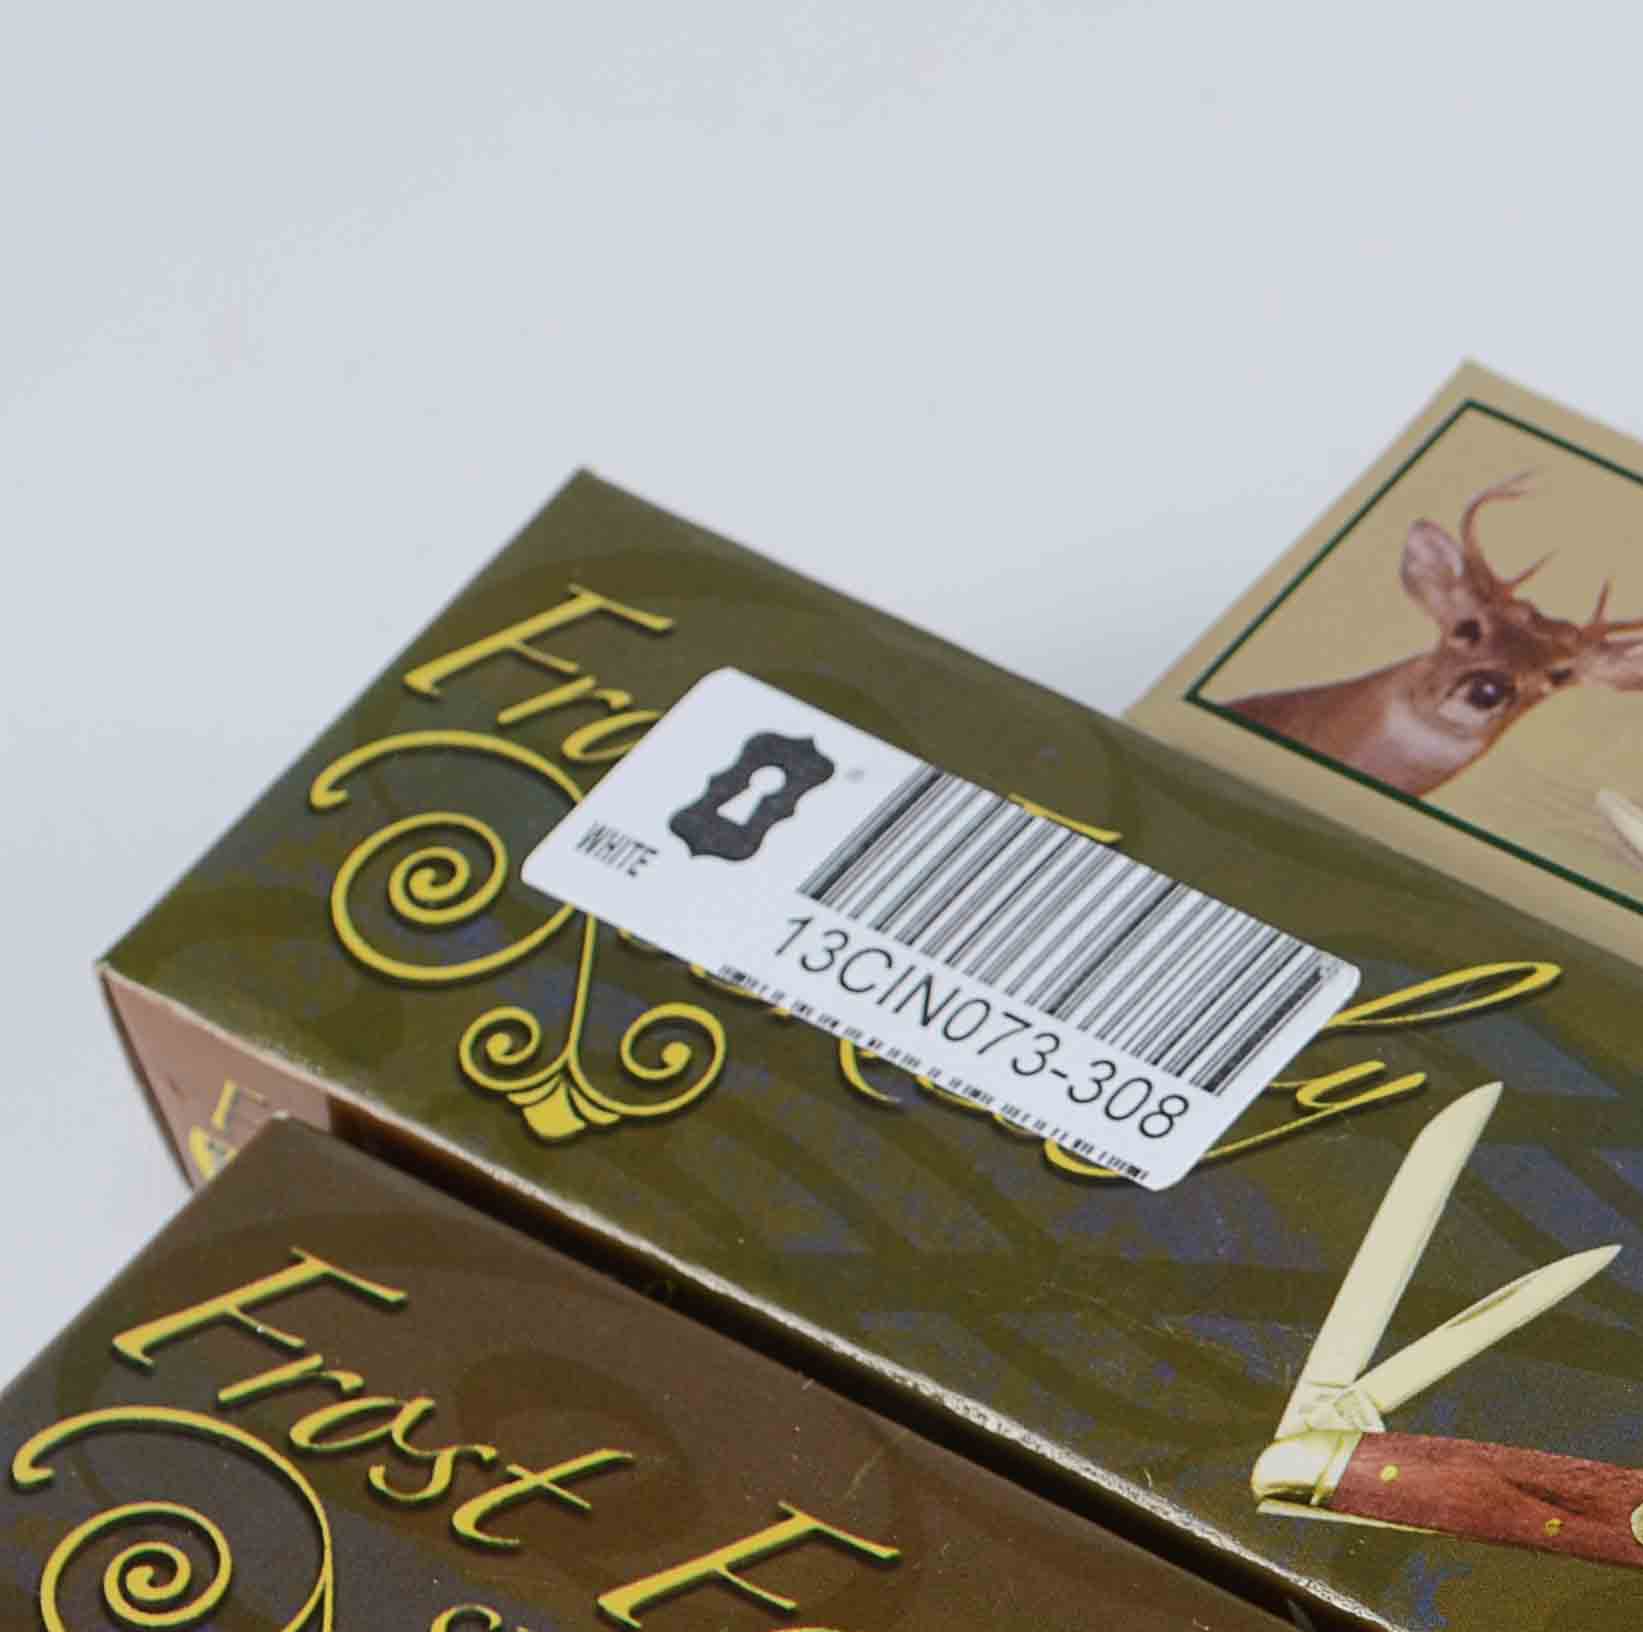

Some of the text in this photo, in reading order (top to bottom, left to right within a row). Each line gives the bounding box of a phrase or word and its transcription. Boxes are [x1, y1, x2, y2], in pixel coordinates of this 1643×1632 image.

[577, 821, 658, 877] WHITE
[769, 915, 1190, 1138] 13CIN073-308
[109, 1250, 633, 1548] Frost
